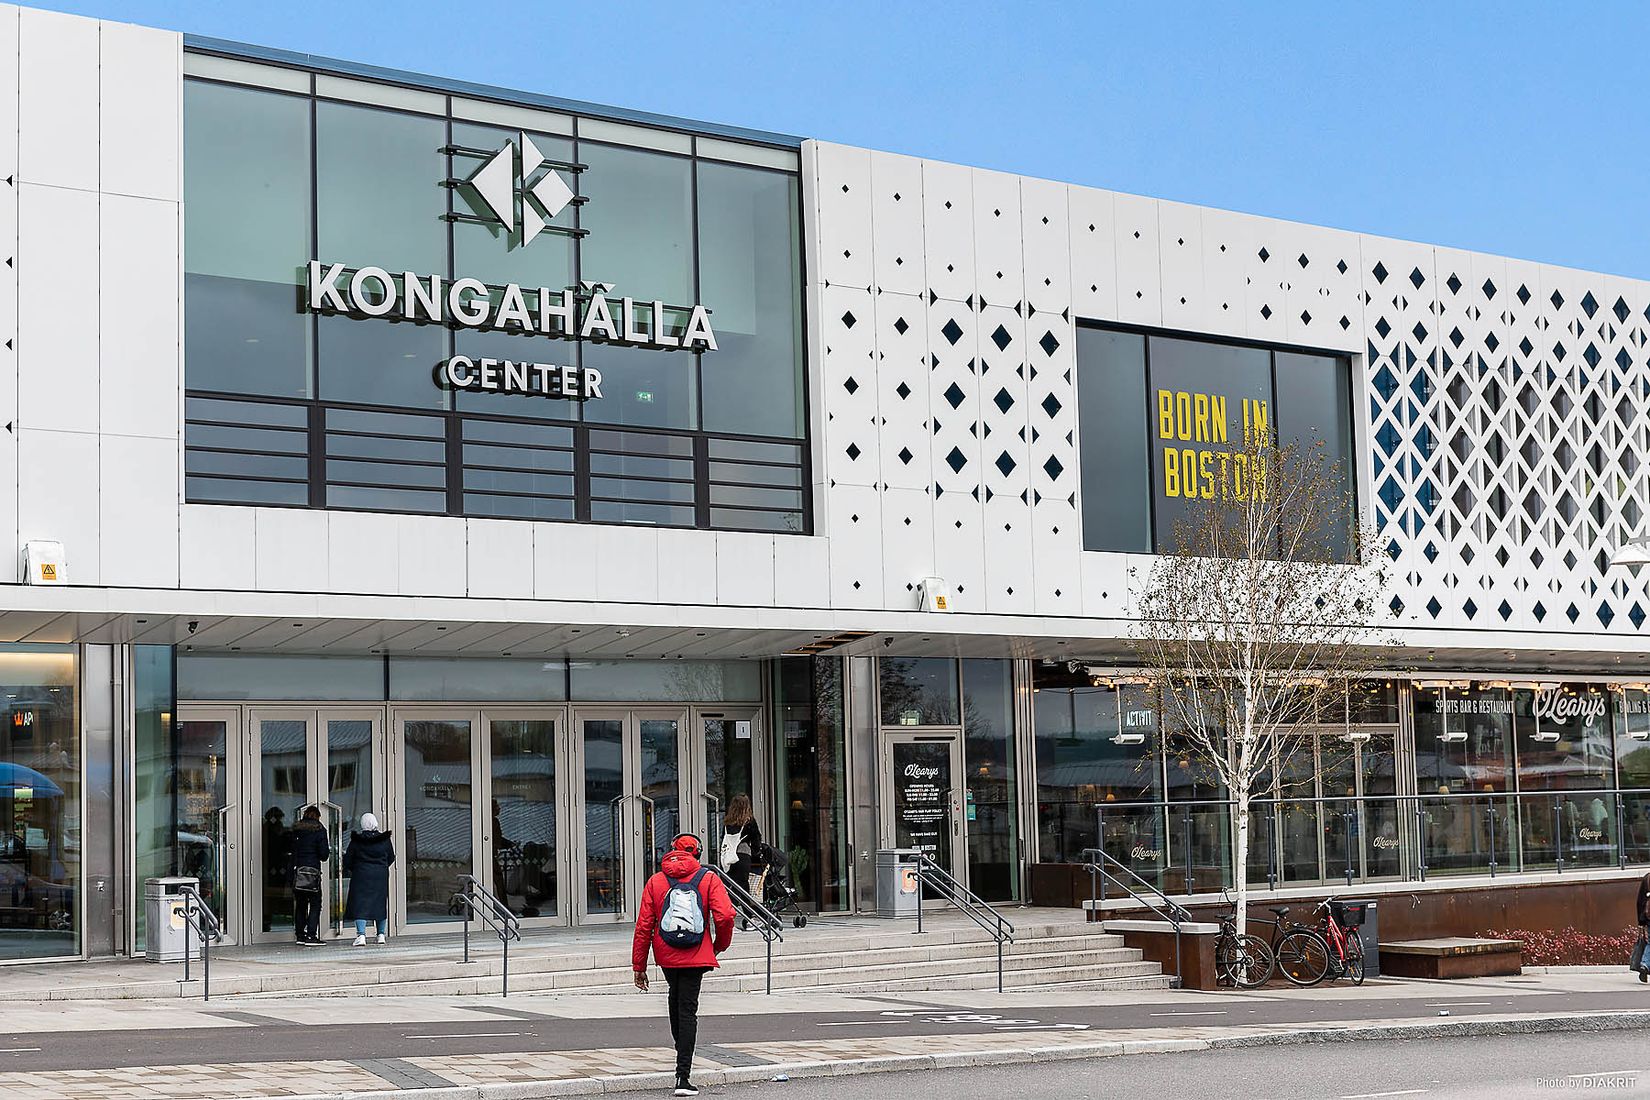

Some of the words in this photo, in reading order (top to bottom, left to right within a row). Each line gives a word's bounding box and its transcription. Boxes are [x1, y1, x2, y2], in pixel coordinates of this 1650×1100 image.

[310, 260, 719, 351] KONGAHÄLLA
[446, 354, 604, 399] CENTER
[1158, 389, 1228, 444] BORN
[1242, 398, 1269, 448] IN
[1164, 447, 1268, 504] BOSTON
[1435, 700, 1459, 713] SPRTS
[1459, 700, 1472, 713] BAR
[1472, 700, 1478, 713] &
[1478, 700, 1514, 714] RESTAURANT
